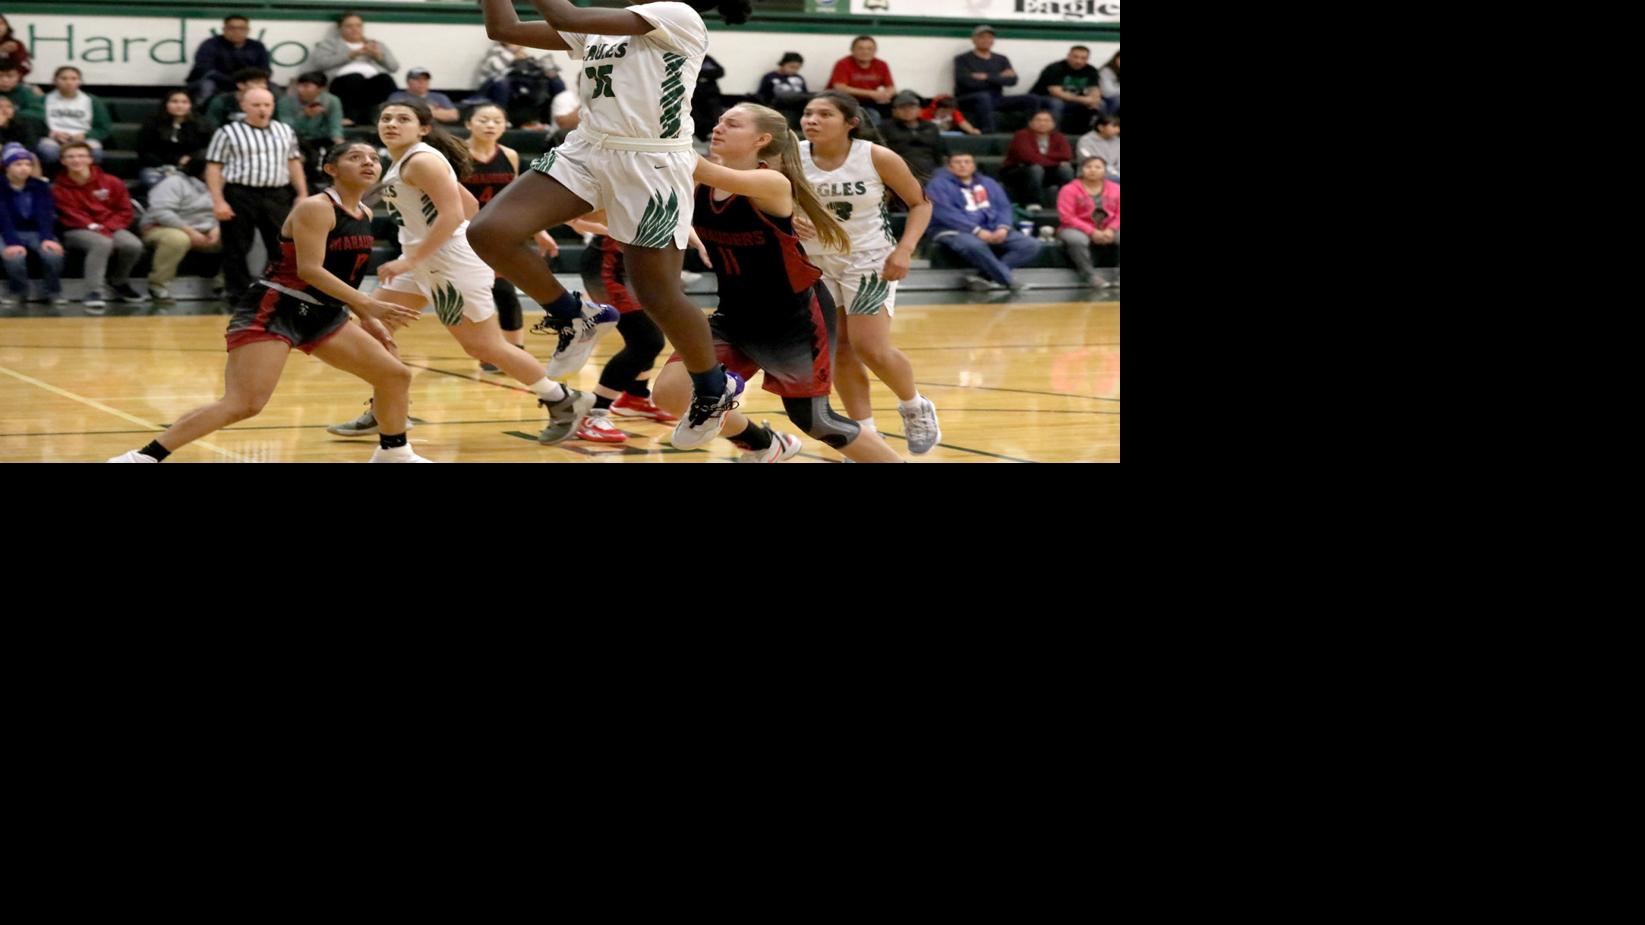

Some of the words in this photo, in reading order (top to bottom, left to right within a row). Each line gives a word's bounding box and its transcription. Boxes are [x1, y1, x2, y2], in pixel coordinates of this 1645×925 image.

[28, 18, 187, 64] Hard
[585, 64, 616, 99] 35
[717, 246, 741, 275] 11
